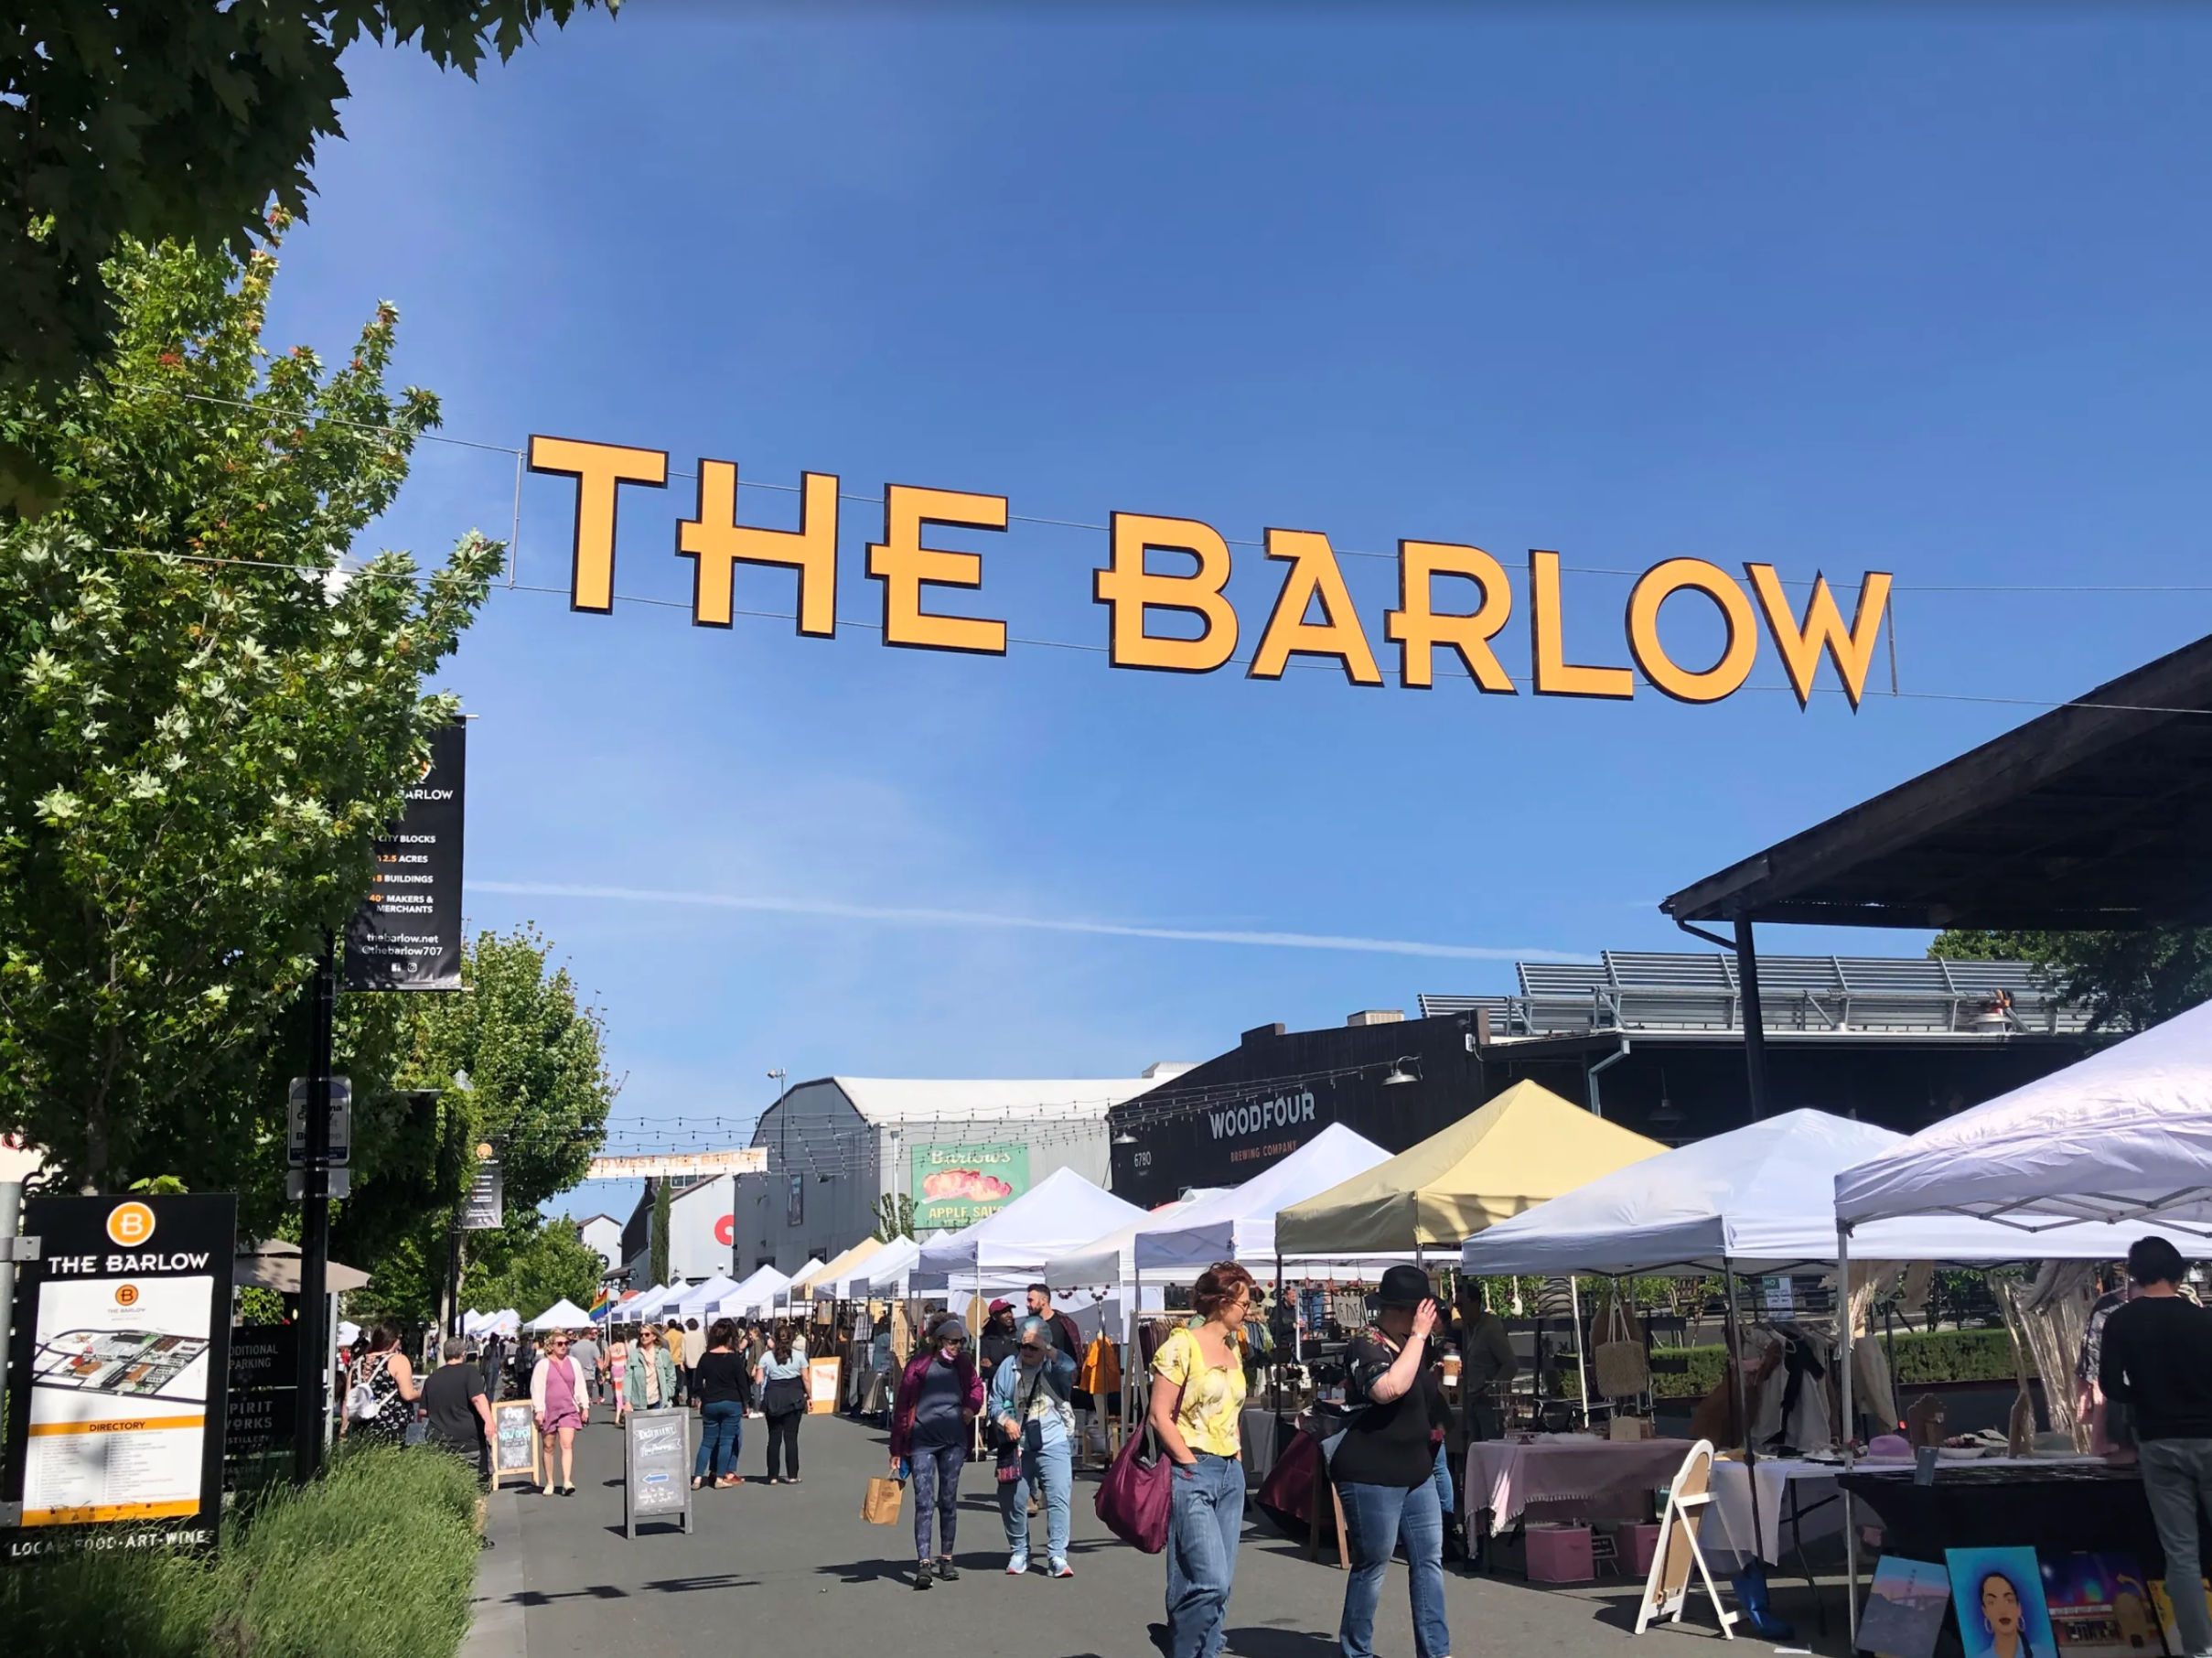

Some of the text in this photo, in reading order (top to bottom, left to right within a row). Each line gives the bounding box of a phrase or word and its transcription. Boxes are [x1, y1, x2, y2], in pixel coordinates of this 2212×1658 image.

[528, 434, 1893, 716] THE BARLOW
[400, 834, 436, 844] BLOCKS
[398, 855, 428, 863] ACRES
[384, 875, 434, 884] BUILDINGS
[386, 895, 424, 903] MAKERS
[376, 904, 434, 913] MERCHANTS
[367, 933, 439, 943] thebarlow.net
[361, 944, 444, 956] @thebarlow707
[1210, 1093, 1315, 1139] WOODFOUR
[1230, 1140, 1297, 1162] BREWING COMPANY
[614, 1157, 655, 1168] WEST
[668, 1155, 693, 1167] THE
[701, 1150, 761, 1165] BARLOW
[120, 1212, 144, 1236] B
[48, 1253, 209, 1275] THE BARLOW
[120, 1288, 134, 1302] B
[230, 1344, 278, 1356] DDITIONAL
[230, 1357, 272, 1369] PARKING
[229, 1400, 274, 1415] PIRIT
[89, 1421, 145, 1432] DIRECTORY
